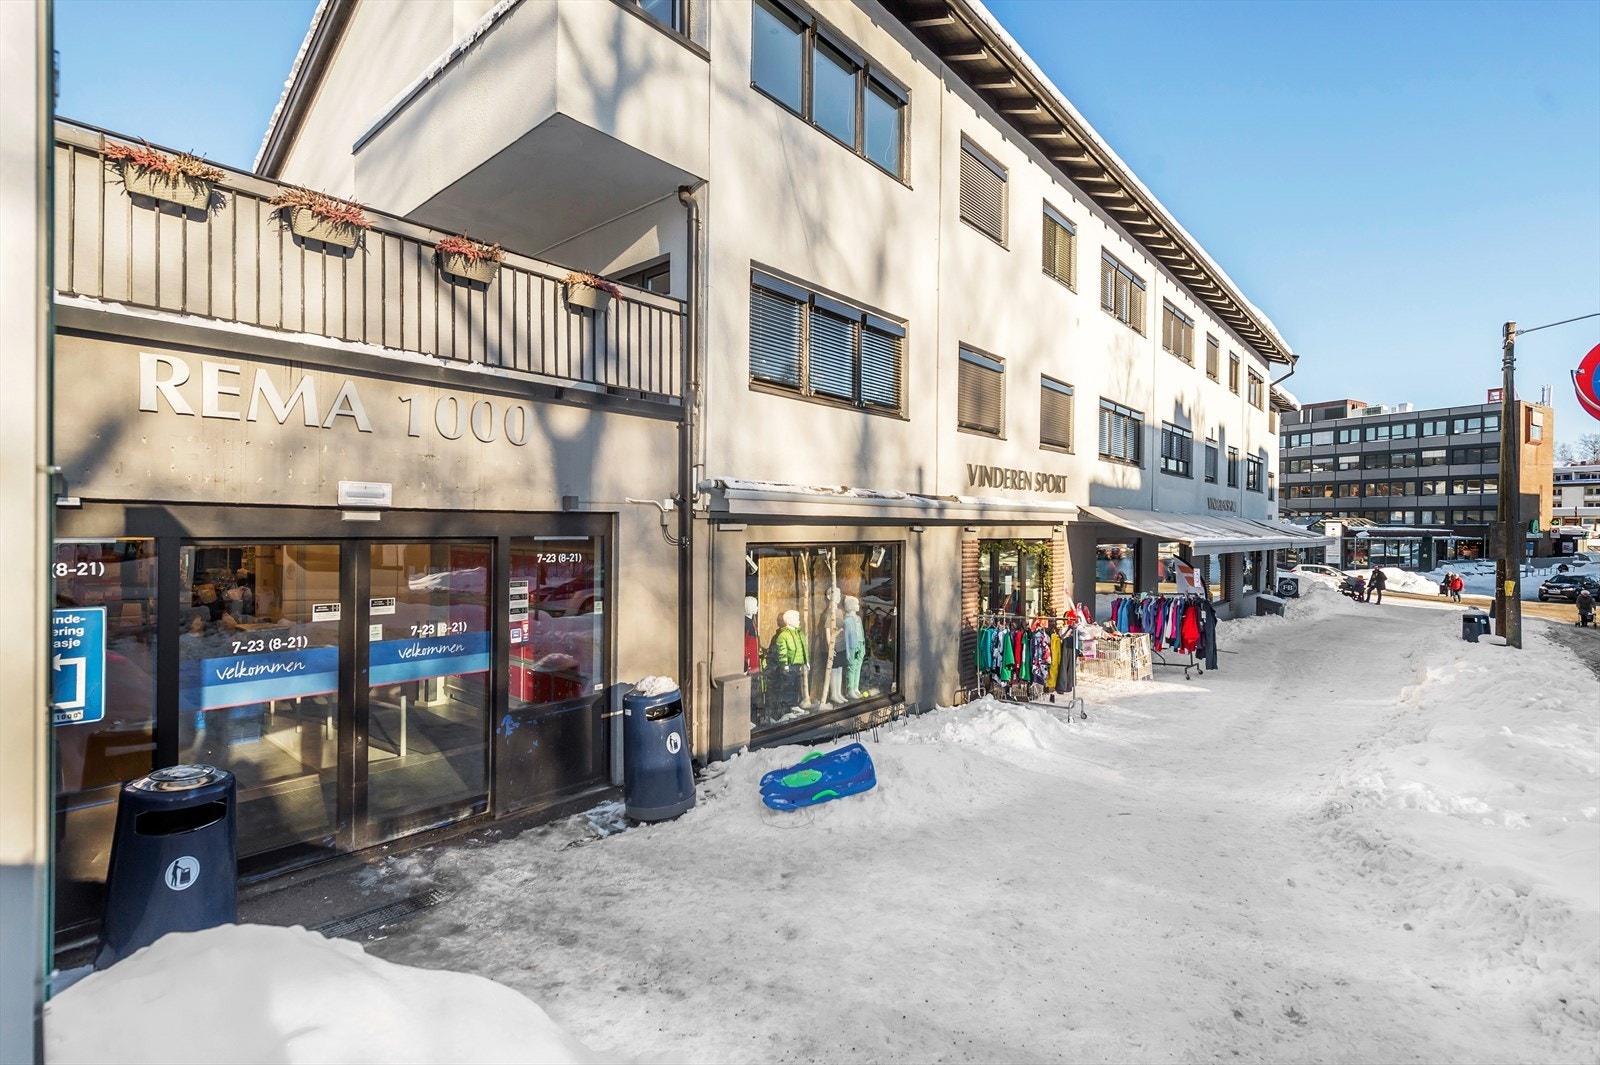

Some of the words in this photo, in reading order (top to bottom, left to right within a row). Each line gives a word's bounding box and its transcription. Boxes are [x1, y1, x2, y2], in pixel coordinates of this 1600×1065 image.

[139, 352, 373, 432] REMA
[398, 391, 533, 446] 1000
[966, 463, 1033, 491] VINDEREN
[1034, 472, 1068, 494] SPORT
[537, 553, 557, 563] 7-23
[558, 553, 582, 563] (8-21)
[52, 562, 105, 578] (8-21)
[53, 615, 86, 624] nde-
[410, 624, 435, 636] 7-23
[438, 621, 467, 634] 8-21)
[231, 639, 265, 654] 7-23
[268, 635, 308, 651] (8-21)
